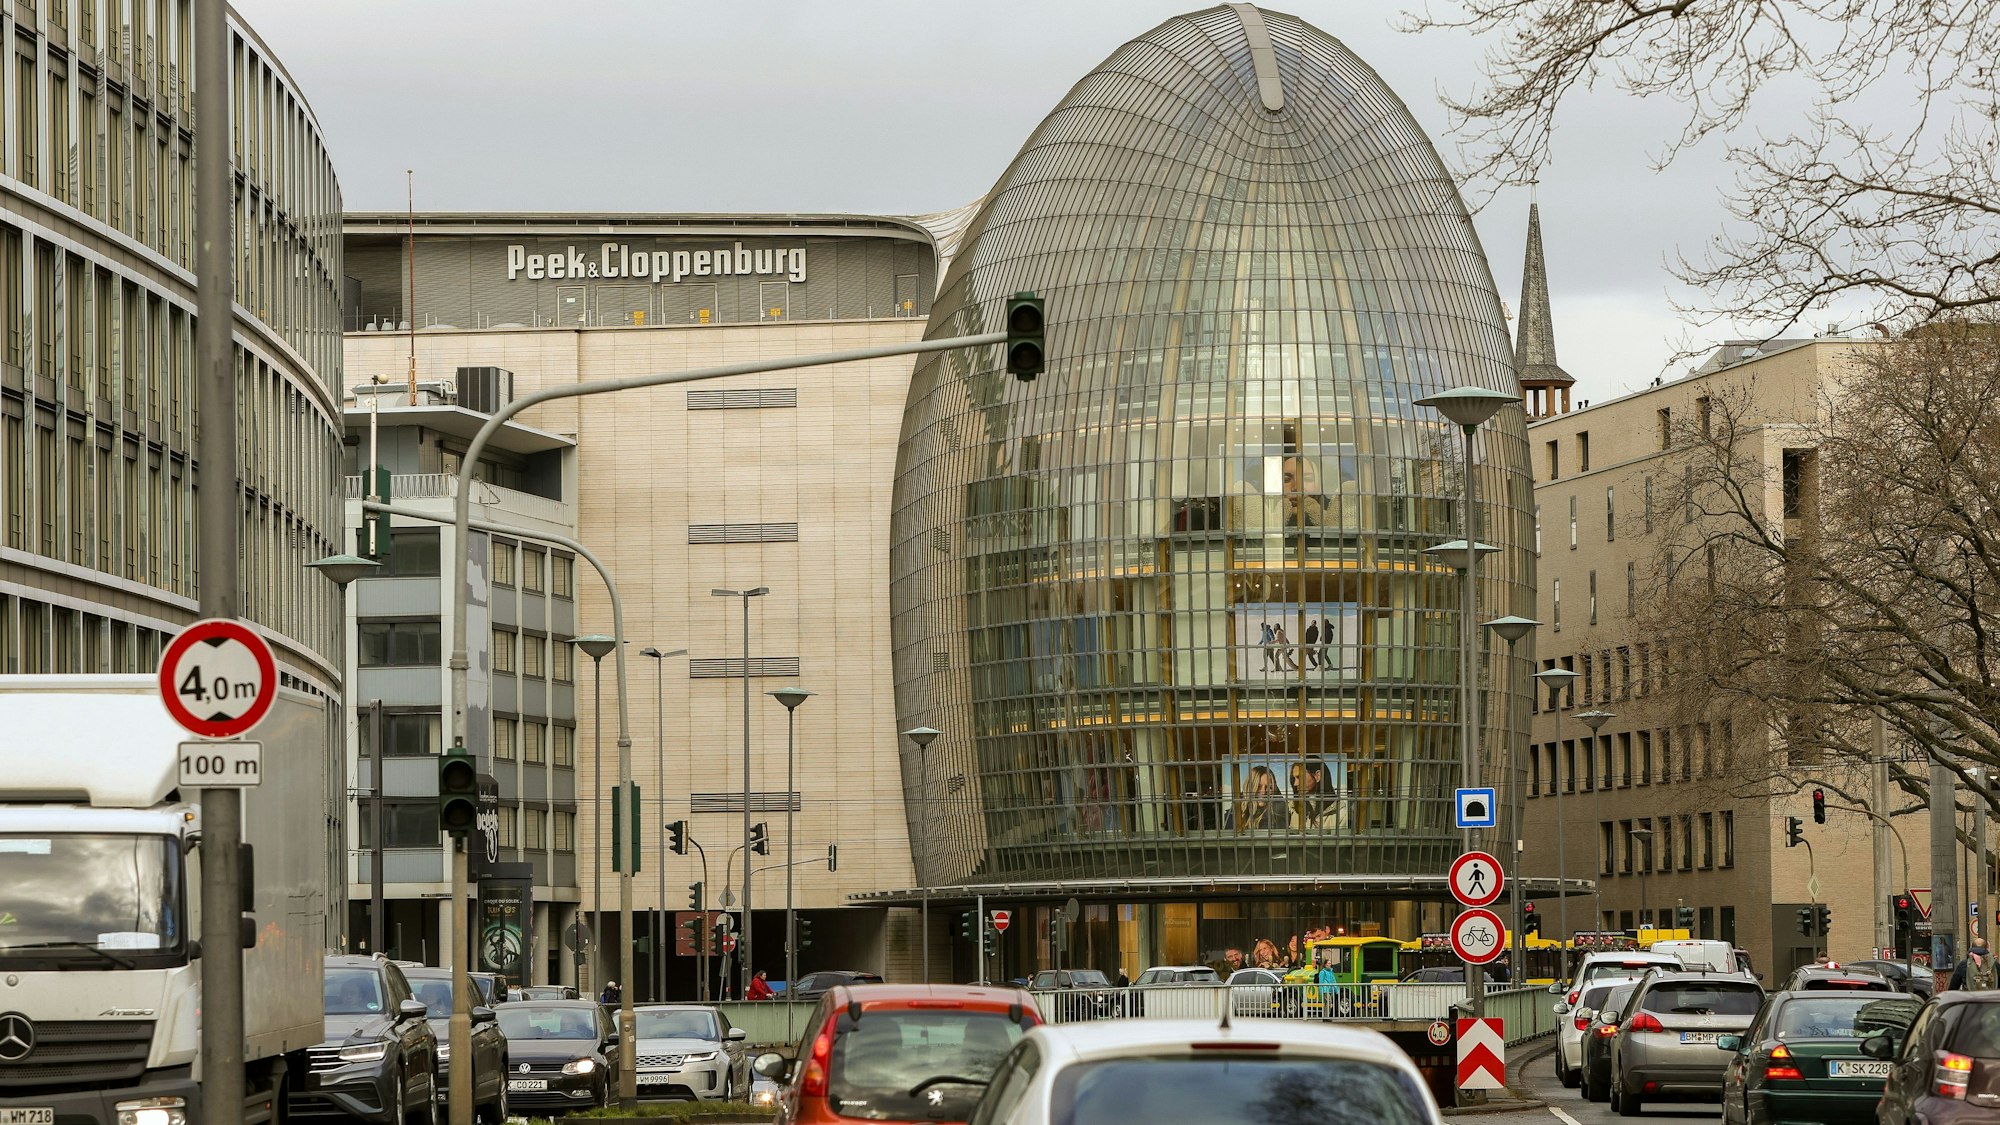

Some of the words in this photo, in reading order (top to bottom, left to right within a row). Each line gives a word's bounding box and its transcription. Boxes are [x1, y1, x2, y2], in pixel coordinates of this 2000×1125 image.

[180, 665, 229, 704] 4,0
[234, 681, 256, 699] m
[180, 755, 225, 775] 100
[235, 760, 257, 774] m
[1686, 1033, 1697, 1041] BM
[1703, 1033, 1714, 1041] MP
[1838, 1063, 1845, 1074] K
[1852, 1063, 1866, 1074] SK
[516, 1081, 528, 1089] CO
[528, 1081, 543, 1089] 221
[10, 1110, 26, 1123] WM
[29, 1110, 52, 1123] 718
